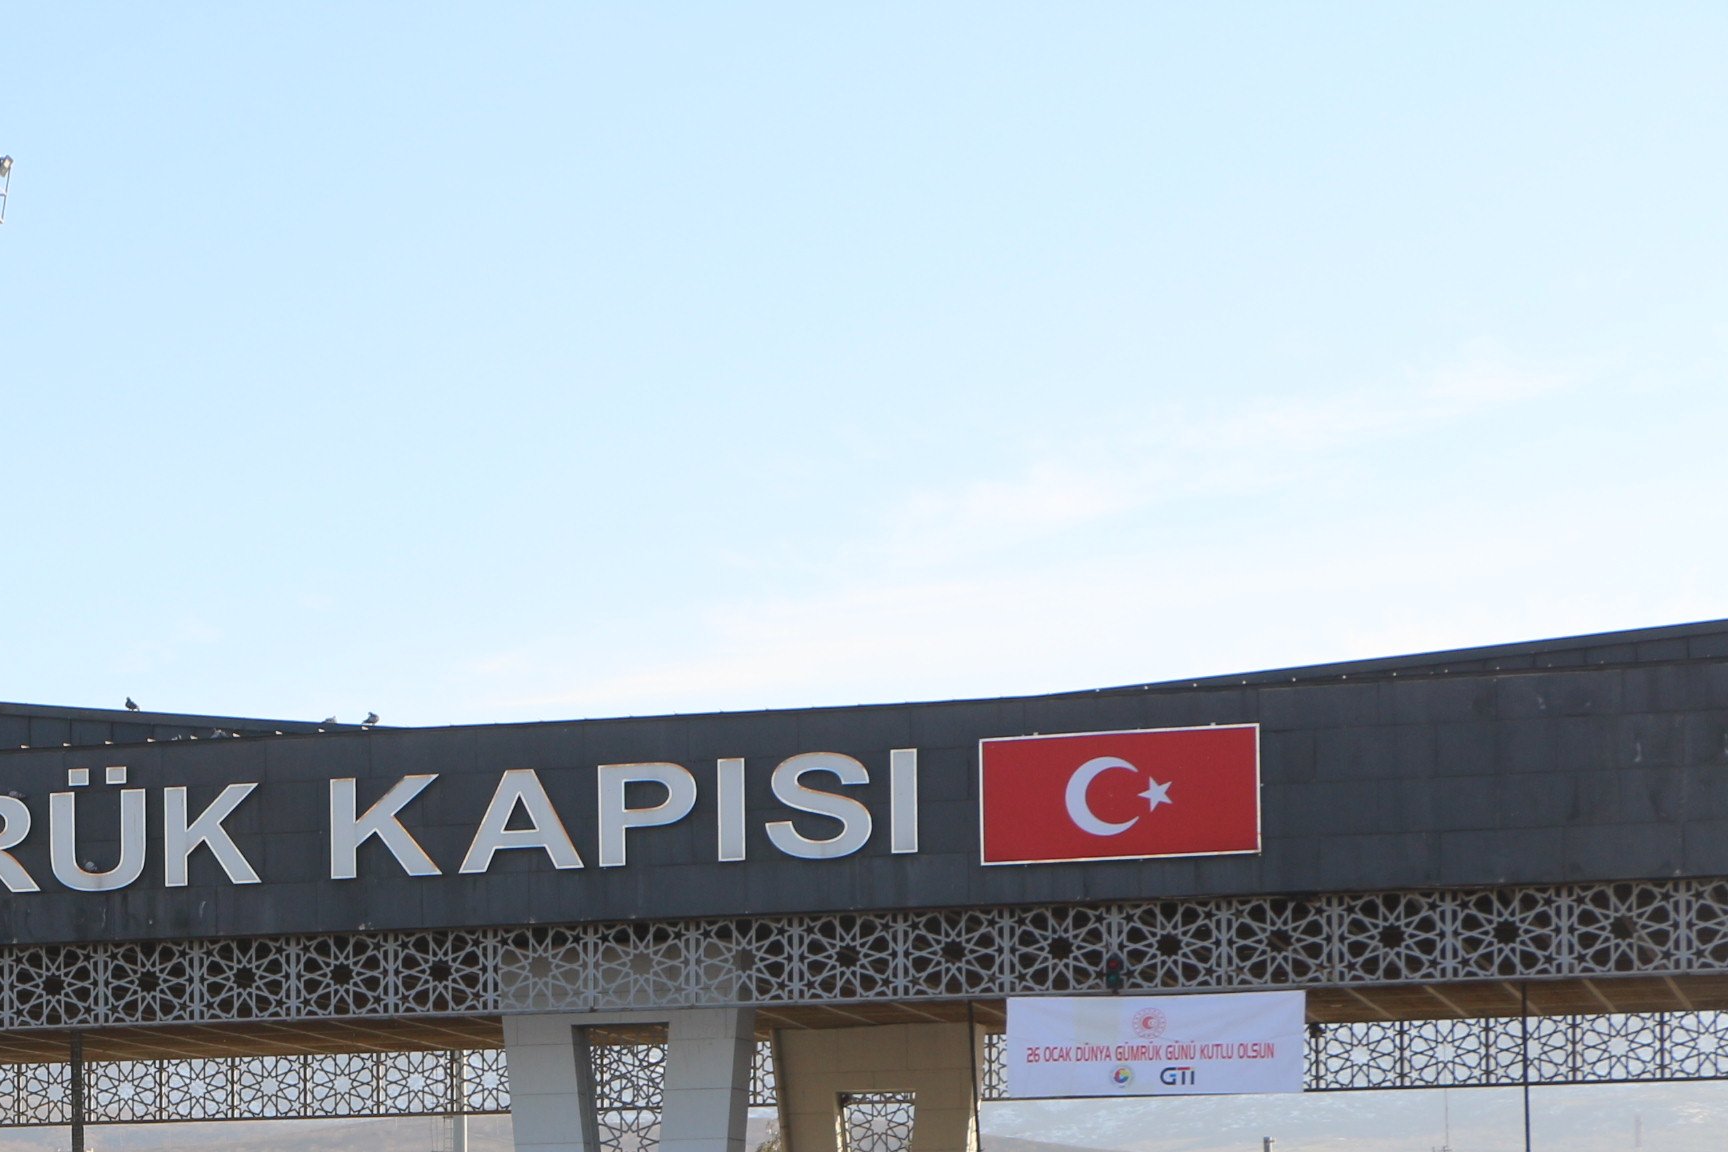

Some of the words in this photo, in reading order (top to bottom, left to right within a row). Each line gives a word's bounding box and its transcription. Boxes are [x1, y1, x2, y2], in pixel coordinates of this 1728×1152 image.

[329, 748, 919, 881] KAPISI
[1026, 1047, 1040, 1063] 26
[1044, 1046, 1071, 1062] OCAK
[1076, 1043, 1112, 1062] DÜNYA
[1116, 1041, 1162, 1061] GÜMRÜK
[1166, 1040, 1196, 1060] GÜNÜ
[1200, 1043, 1233, 1060] KUTLU
[1238, 1042, 1275, 1059] OLSUN
